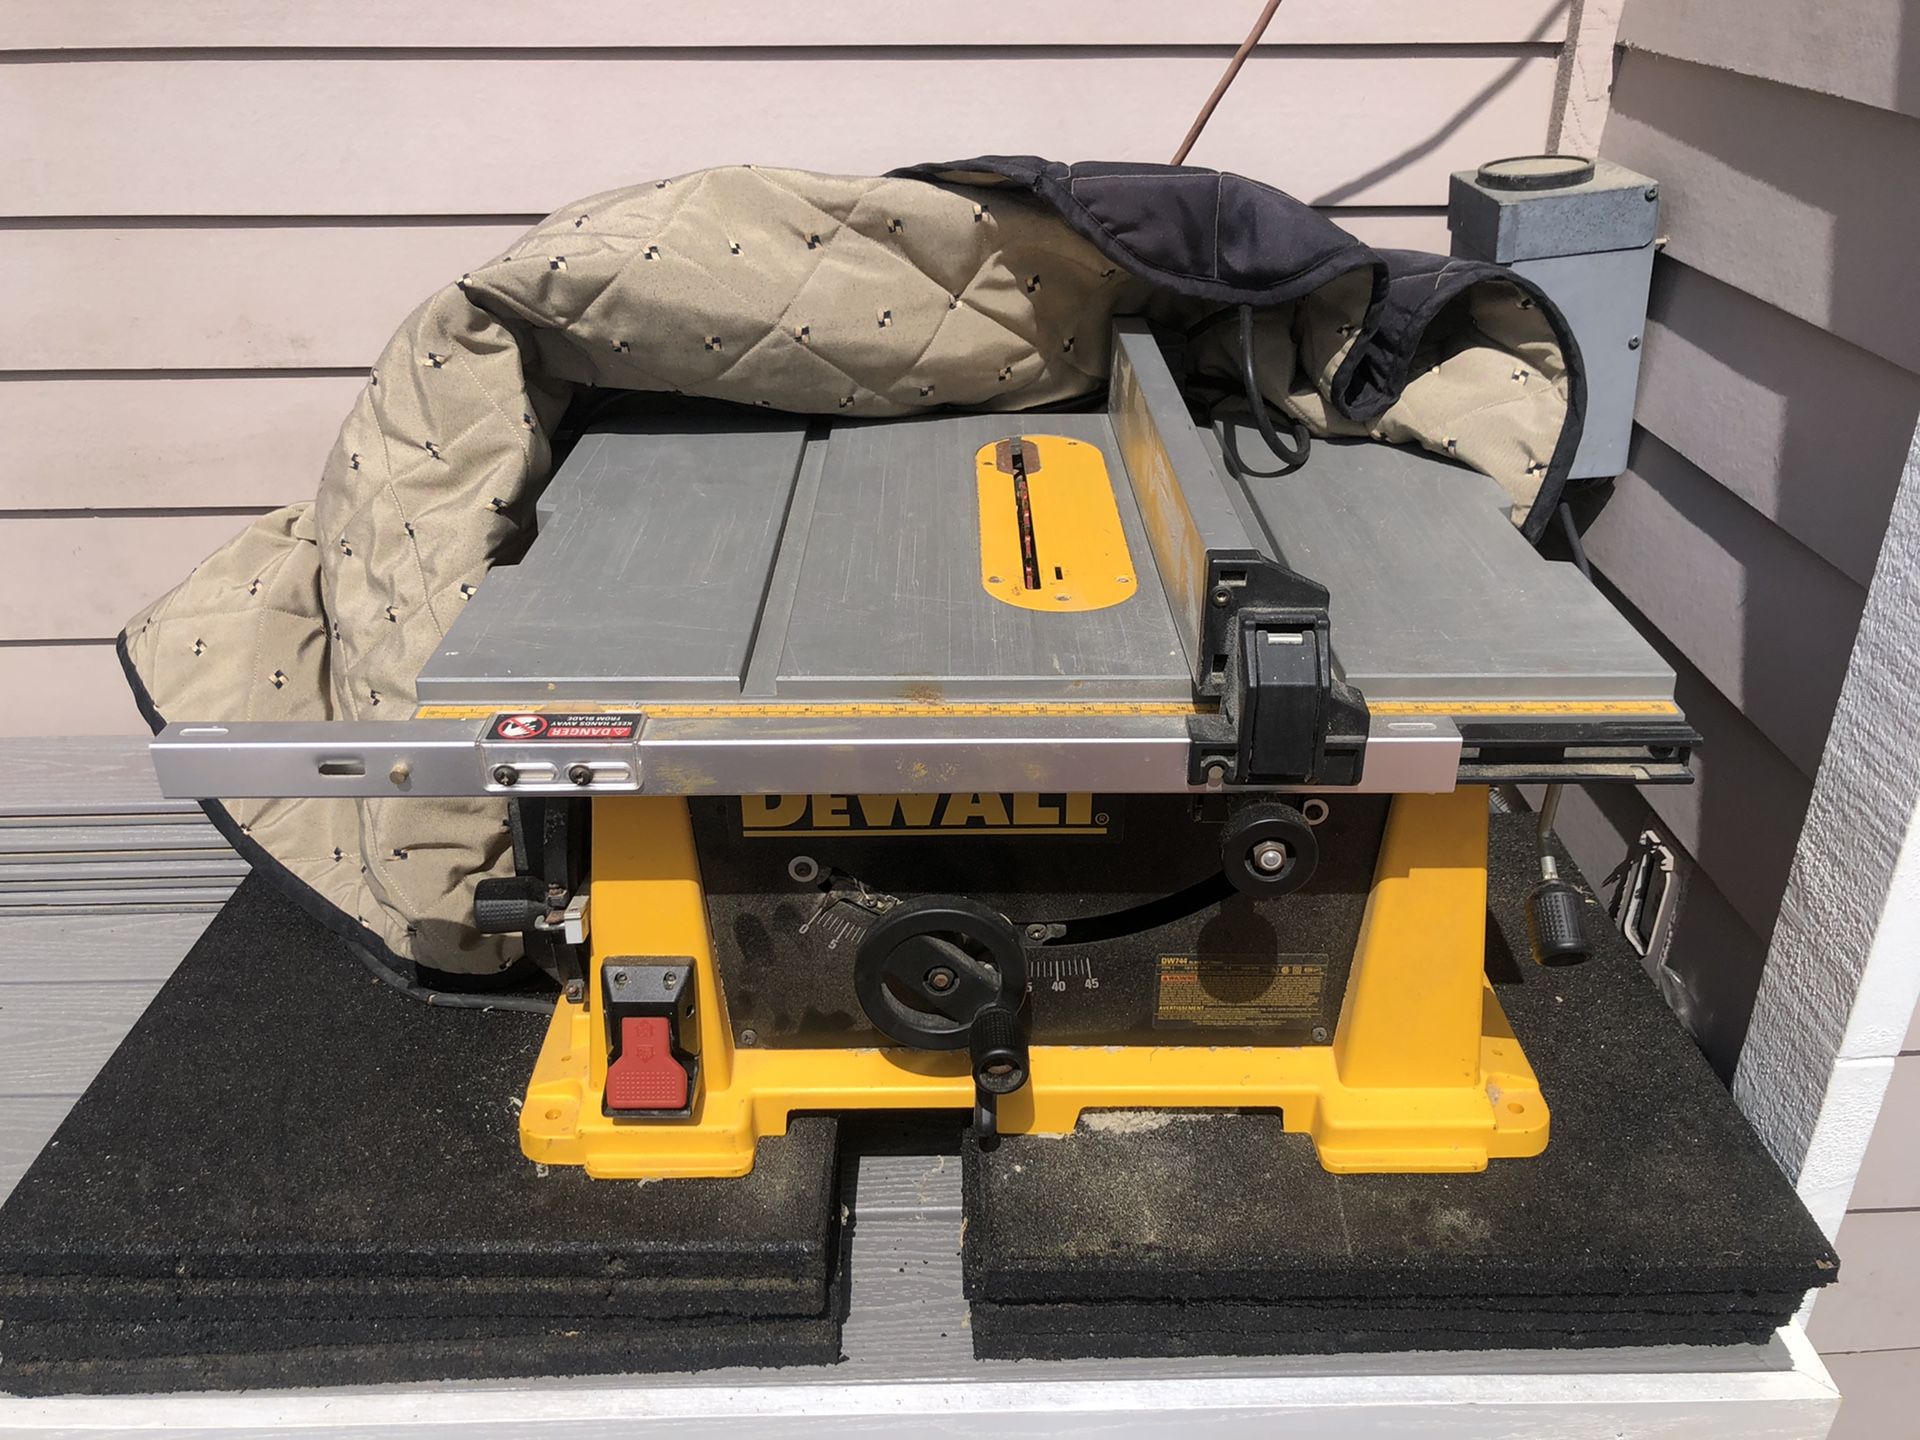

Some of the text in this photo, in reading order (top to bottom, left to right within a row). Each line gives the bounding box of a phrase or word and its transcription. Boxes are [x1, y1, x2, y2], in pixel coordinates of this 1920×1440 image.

[551, 728, 611, 736] DANGER
[799, 923, 809, 934] 0
[828, 939, 839, 950] 5
[1051, 981, 1066, 992] 40
[1084, 978, 1100, 989] 45
